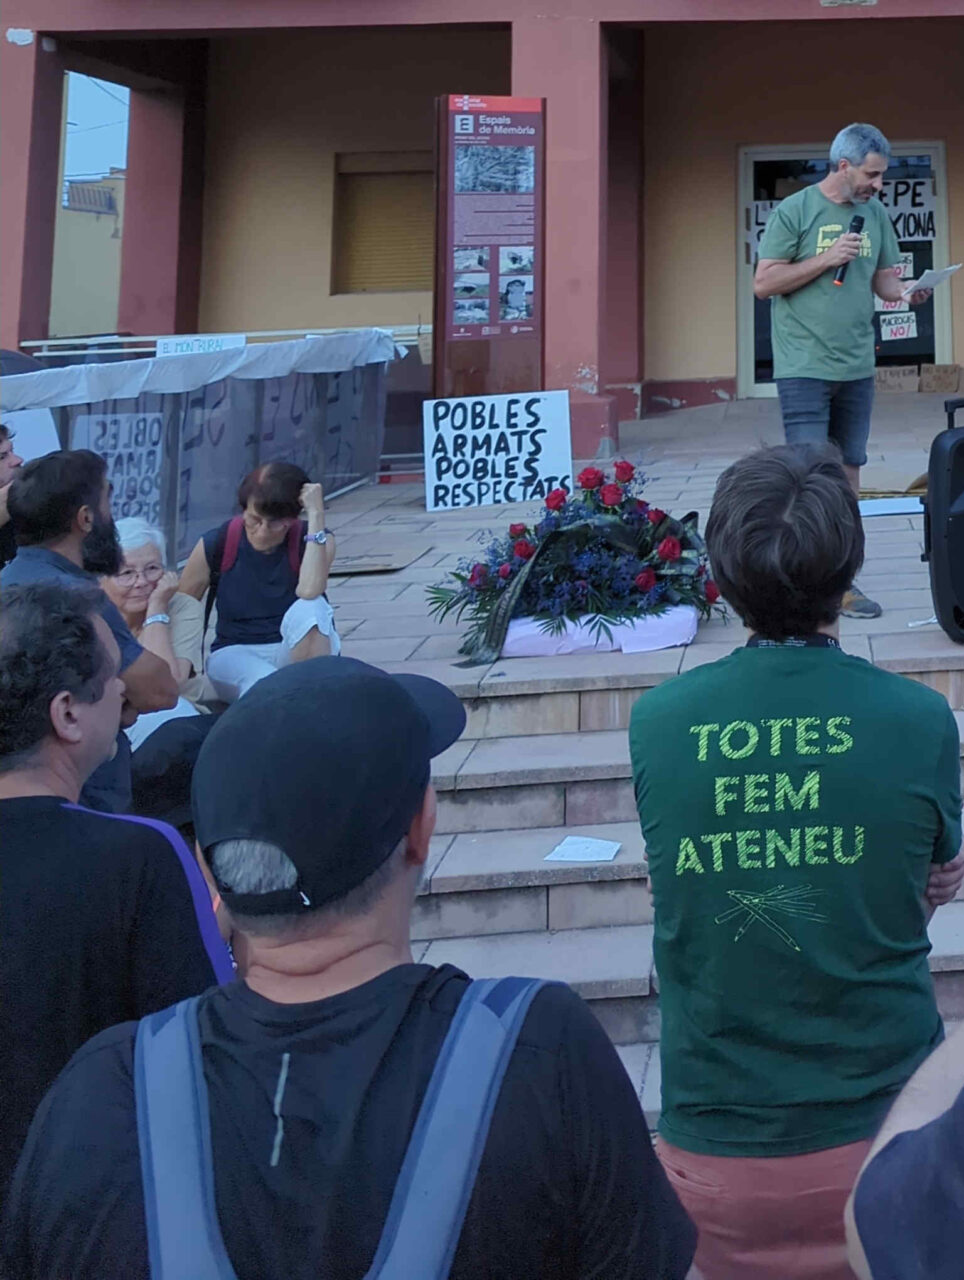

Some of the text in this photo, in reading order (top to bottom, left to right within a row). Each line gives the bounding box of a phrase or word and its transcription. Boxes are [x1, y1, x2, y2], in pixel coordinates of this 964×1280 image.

[479, 115, 511, 125] Espais
[479, 126, 491, 134] de
[433, 398, 541, 432] POBLES
[432, 429, 547, 458] ARMATS
[436, 456, 540, 483] POBLES
[433, 475, 570, 508] RESPECTATS
[689, 716, 853, 762] TOTES
[715, 770, 820, 816] FEM
[676, 825, 865, 876] ATENEU
